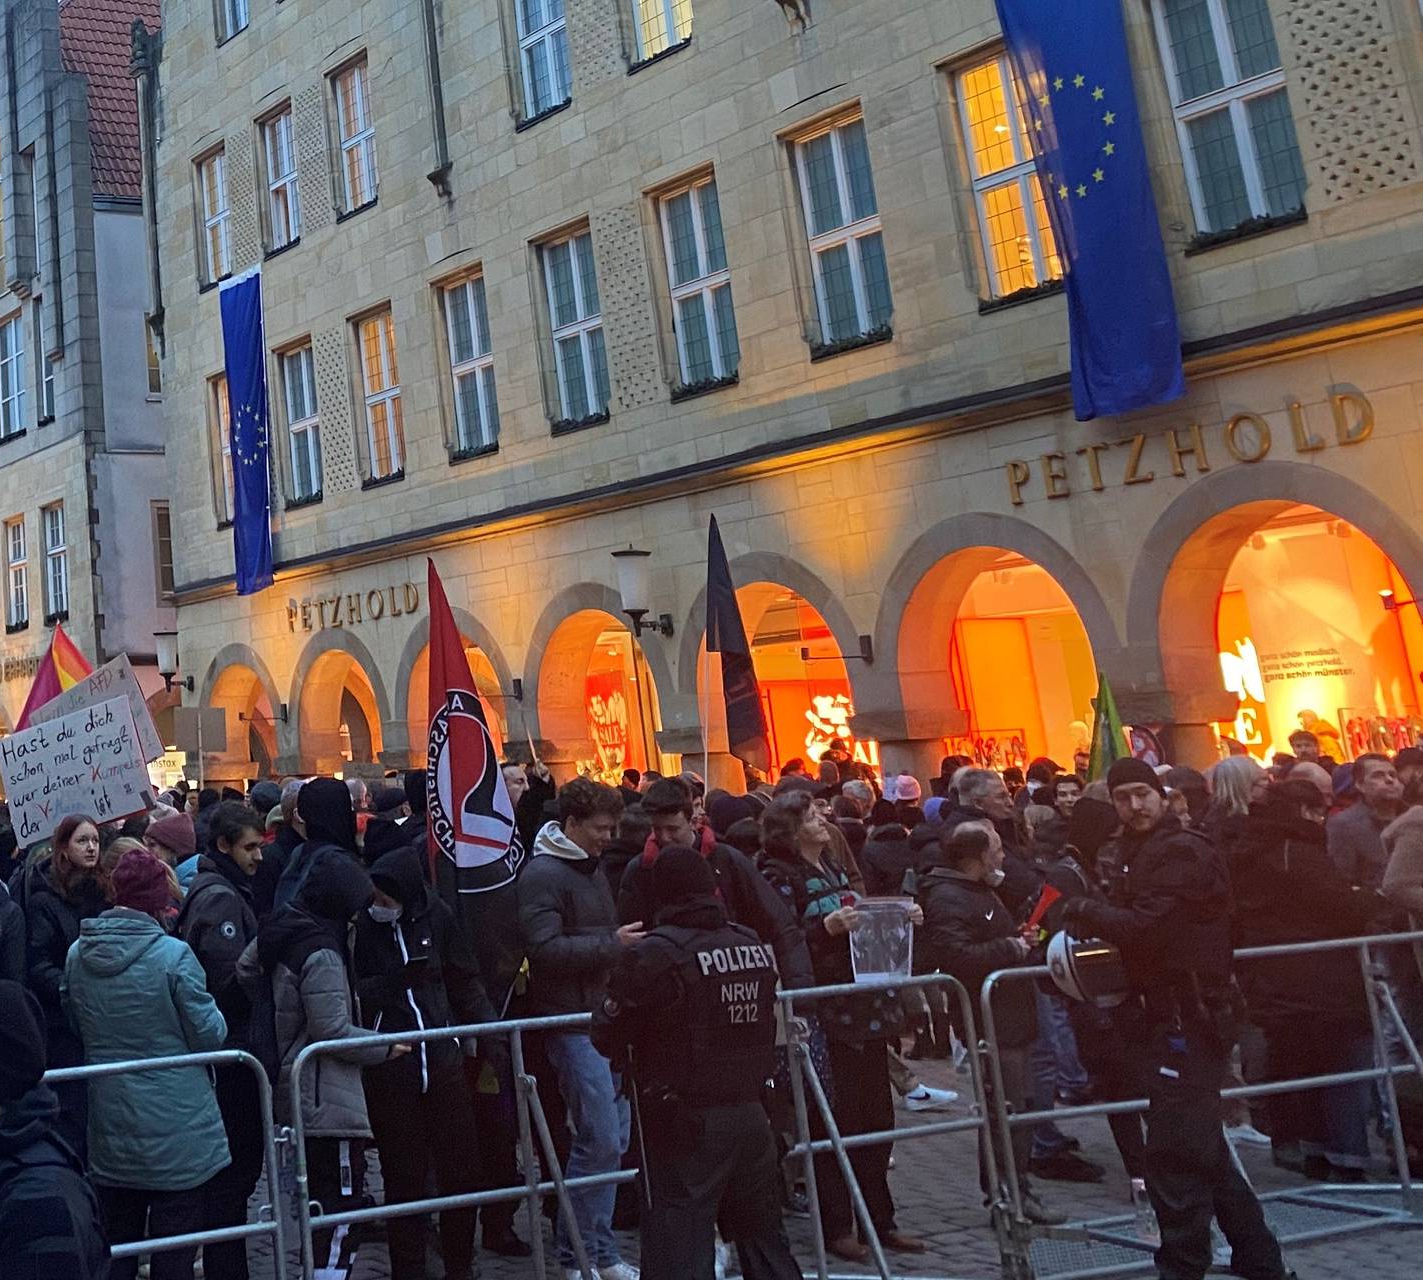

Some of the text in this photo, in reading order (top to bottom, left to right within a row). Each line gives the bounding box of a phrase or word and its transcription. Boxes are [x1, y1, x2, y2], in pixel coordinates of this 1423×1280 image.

[1005, 392, 1375, 506] PETZHOLD
[285, 582, 419, 633] PETZHOLD
[1, 728, 49, 768] Hast
[57, 722, 76, 742] du
[85, 704, 113, 733] dich
[10, 763, 43, 785] schon
[54, 748, 78, 766] mal
[14, 787, 38, 808] wer
[43, 772, 85, 795] deiner
[20, 812, 42, 838] der
[697, 945, 770, 976] POLIZEI
[720, 981, 759, 1003] NRW
[728, 1003, 759, 1024] 1212
